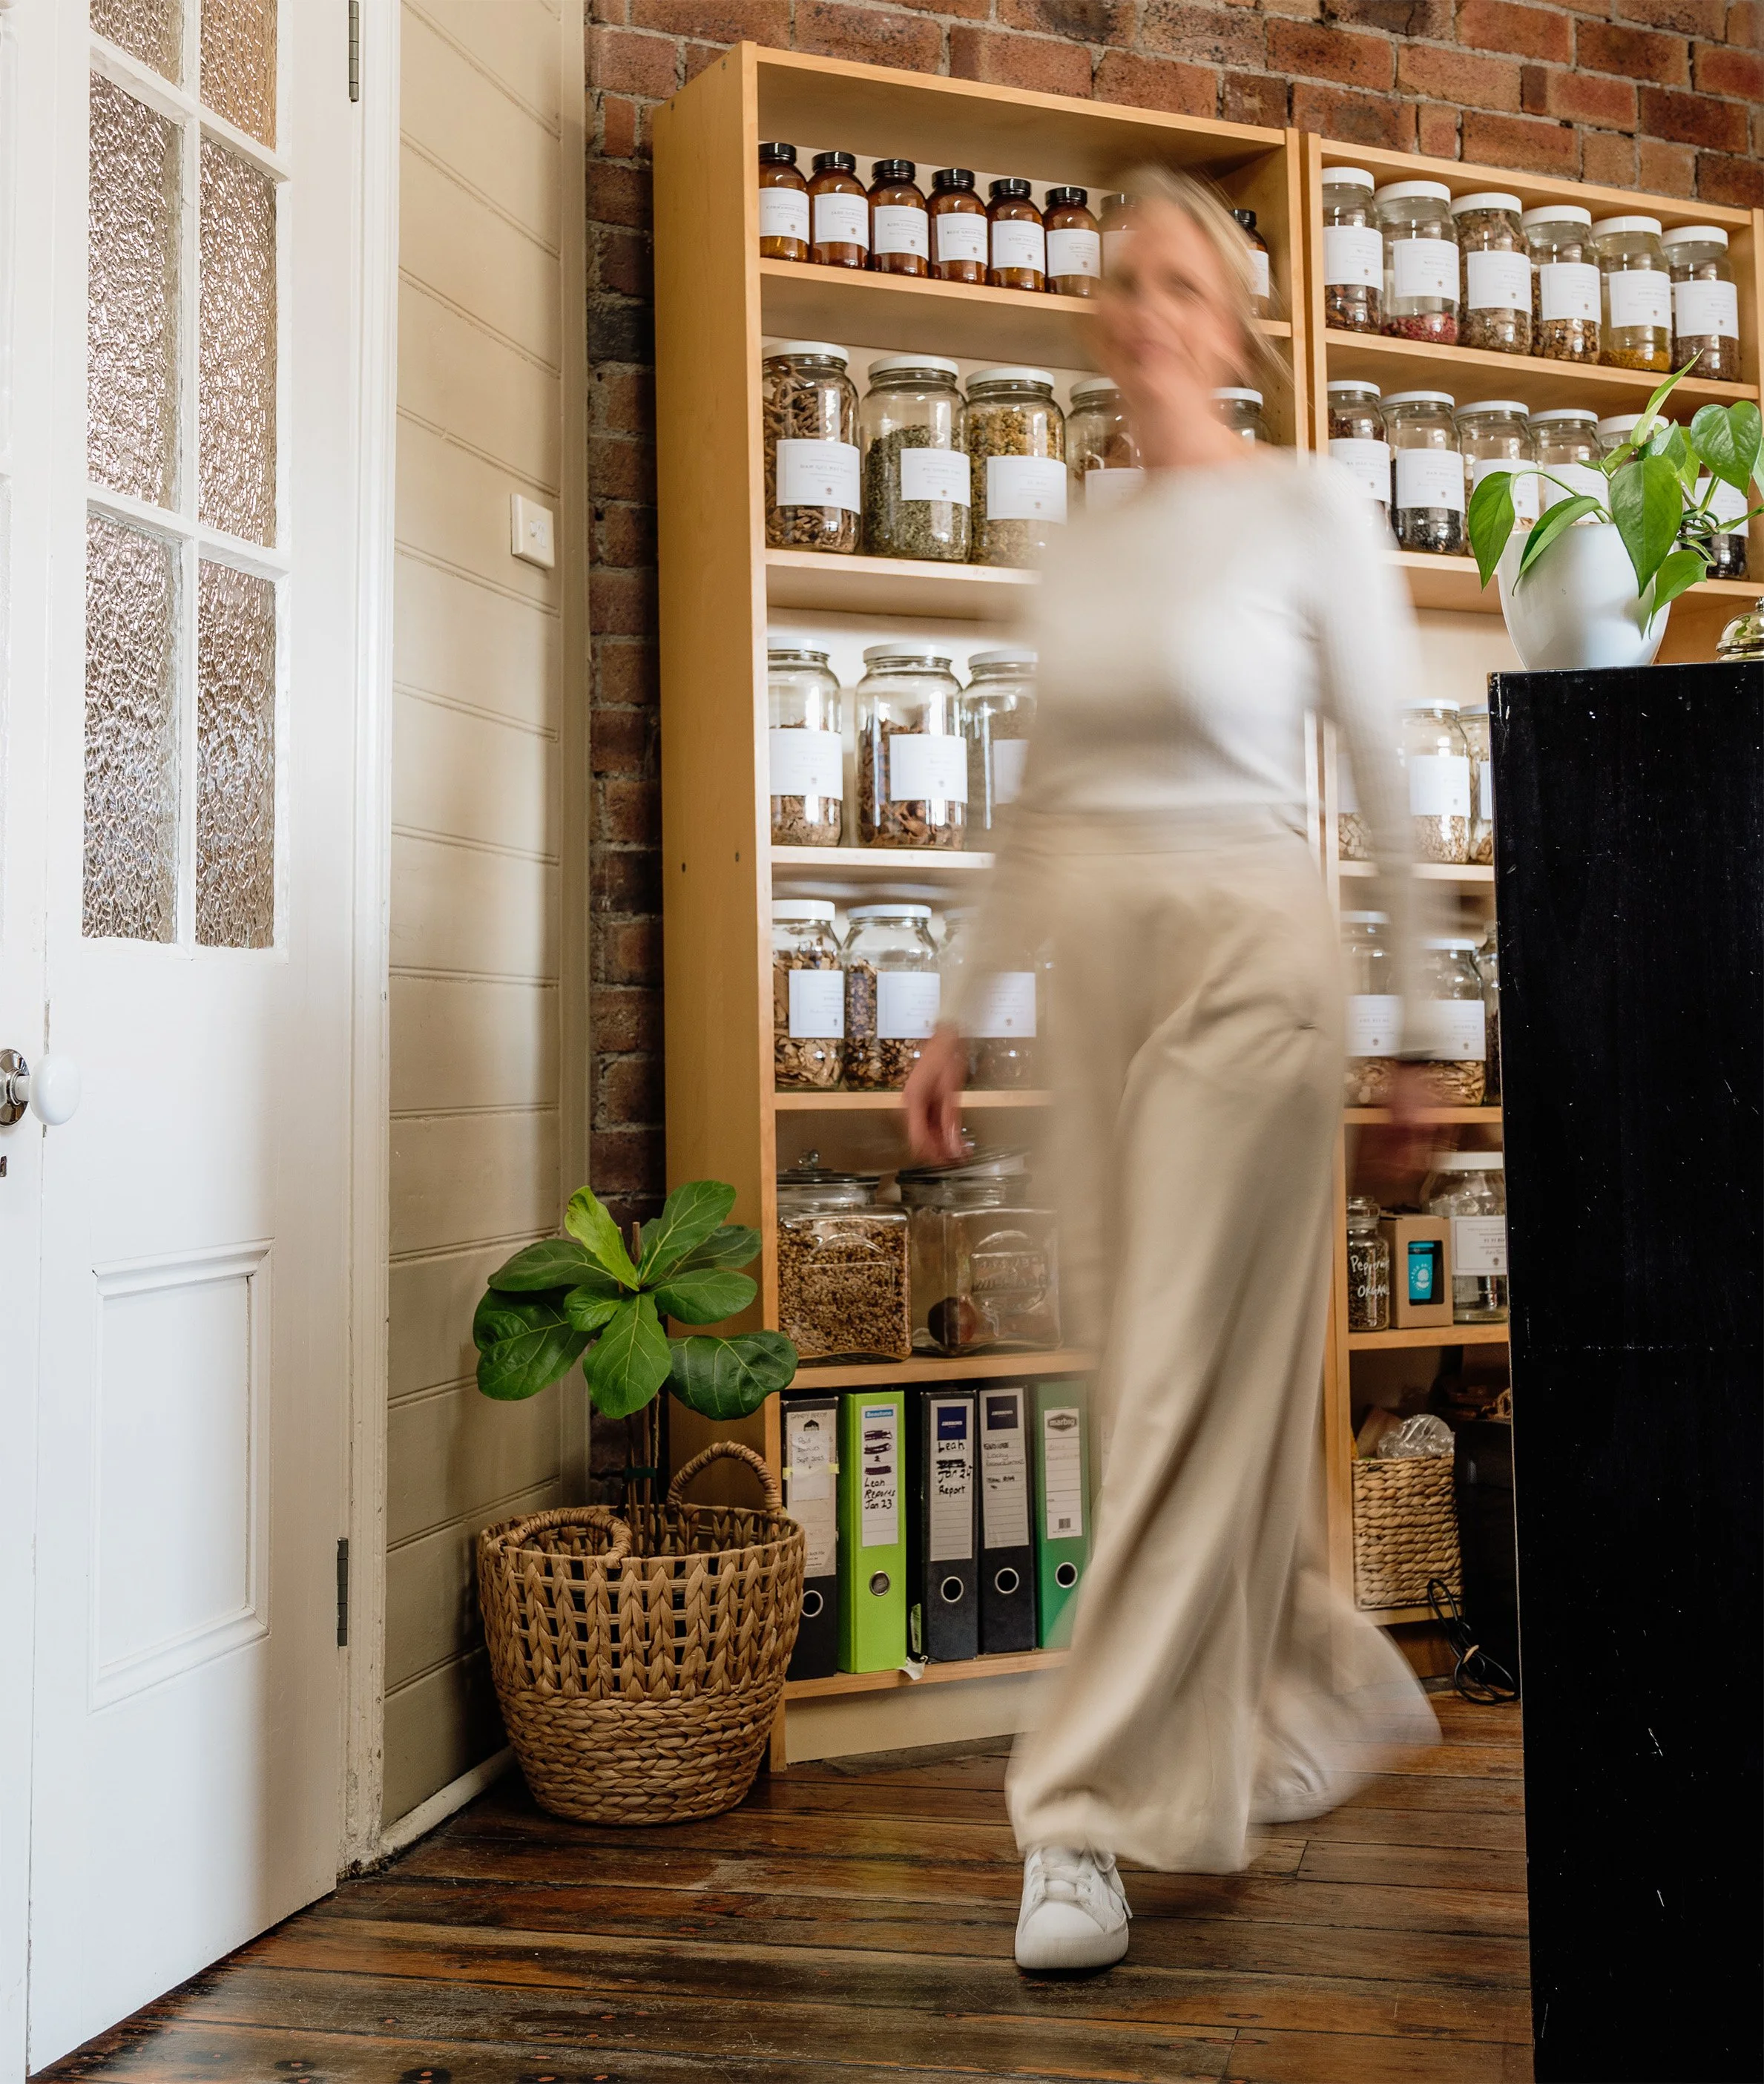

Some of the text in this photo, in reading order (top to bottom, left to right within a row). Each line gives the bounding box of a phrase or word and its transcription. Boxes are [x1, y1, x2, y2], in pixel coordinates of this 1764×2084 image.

[938, 1439, 965, 1453] Leah
[864, 1478, 885, 1488] Leah
[864, 1489, 895, 1499] Reports
[938, 1485, 965, 1497] Report
[865, 1499, 892, 1509] Jan 23
